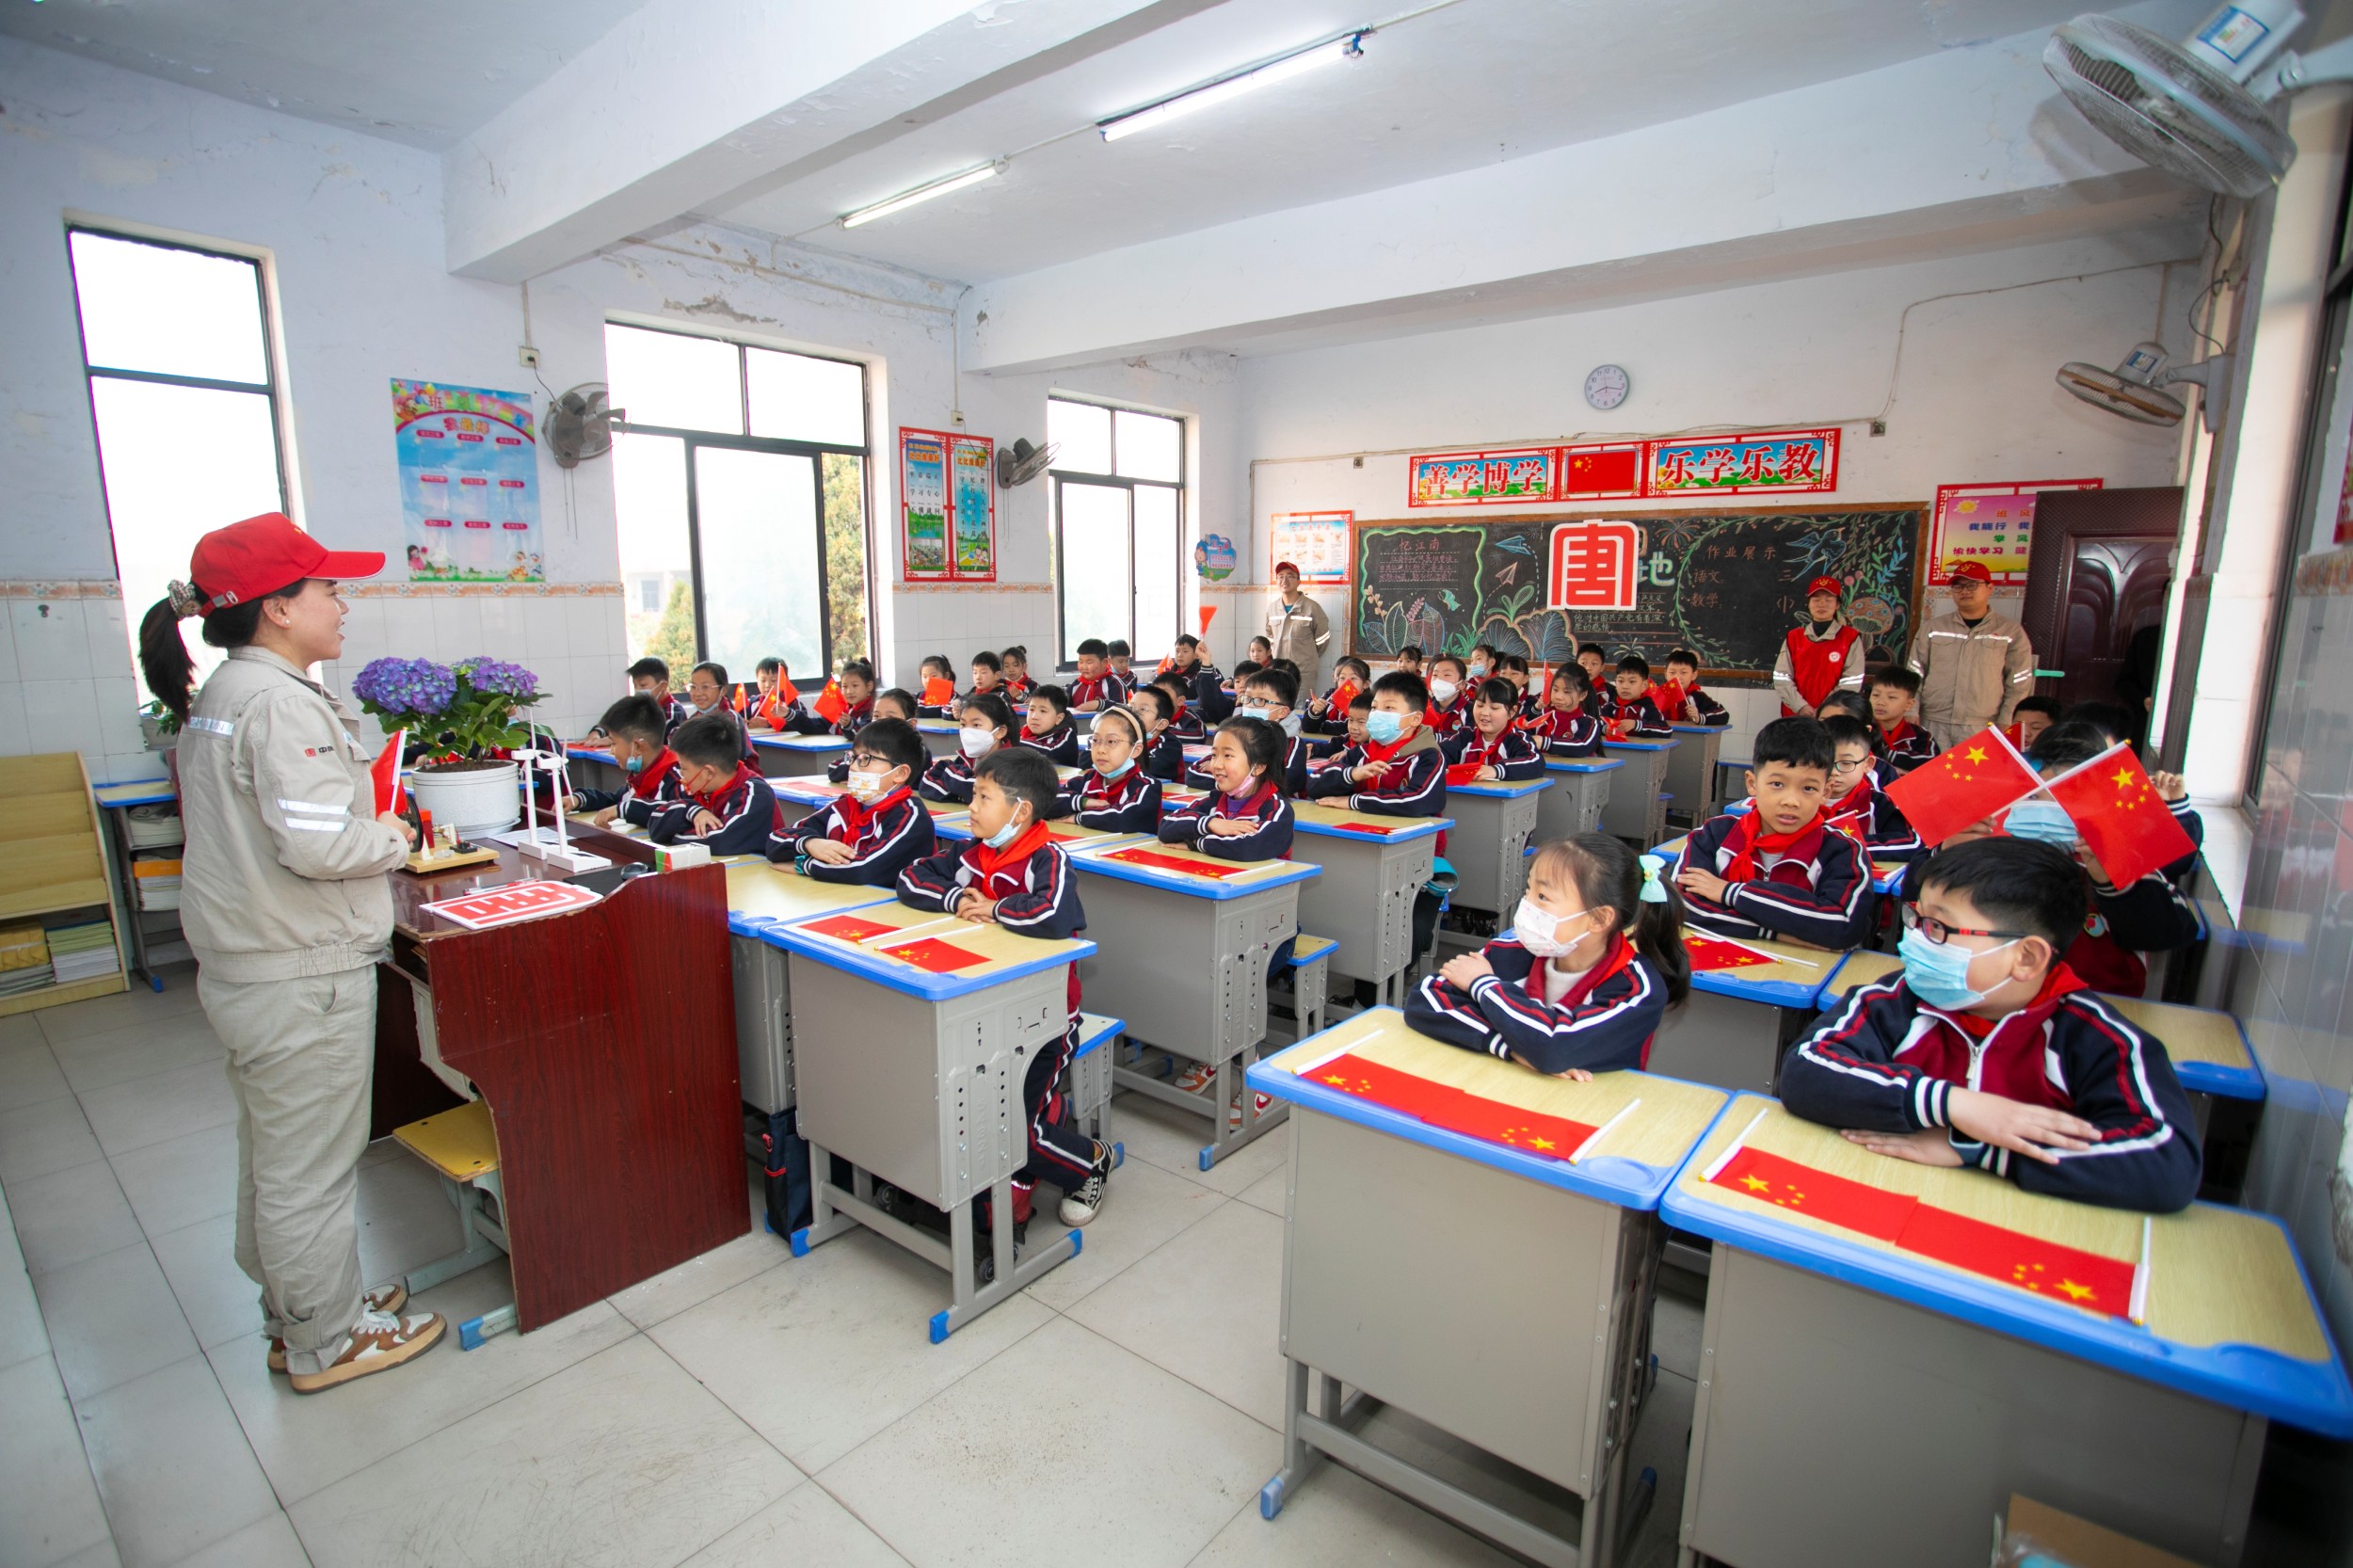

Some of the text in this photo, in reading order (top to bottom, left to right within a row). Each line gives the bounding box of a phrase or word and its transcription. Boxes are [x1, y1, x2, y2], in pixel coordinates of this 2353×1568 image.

[1662, 442, 1819, 485] 乐学乐教
[1423, 459, 1545, 496] 善学博学
[1995, 509, 2031, 518] 班风
[1969, 521, 2007, 531] 我能行
[1400, 537, 1440, 552] 忆江南
[1993, 535, 2029, 543] 学风
[1706, 545, 1777, 560] 作业展示
[1952, 547, 2004, 556] 愉快学习
